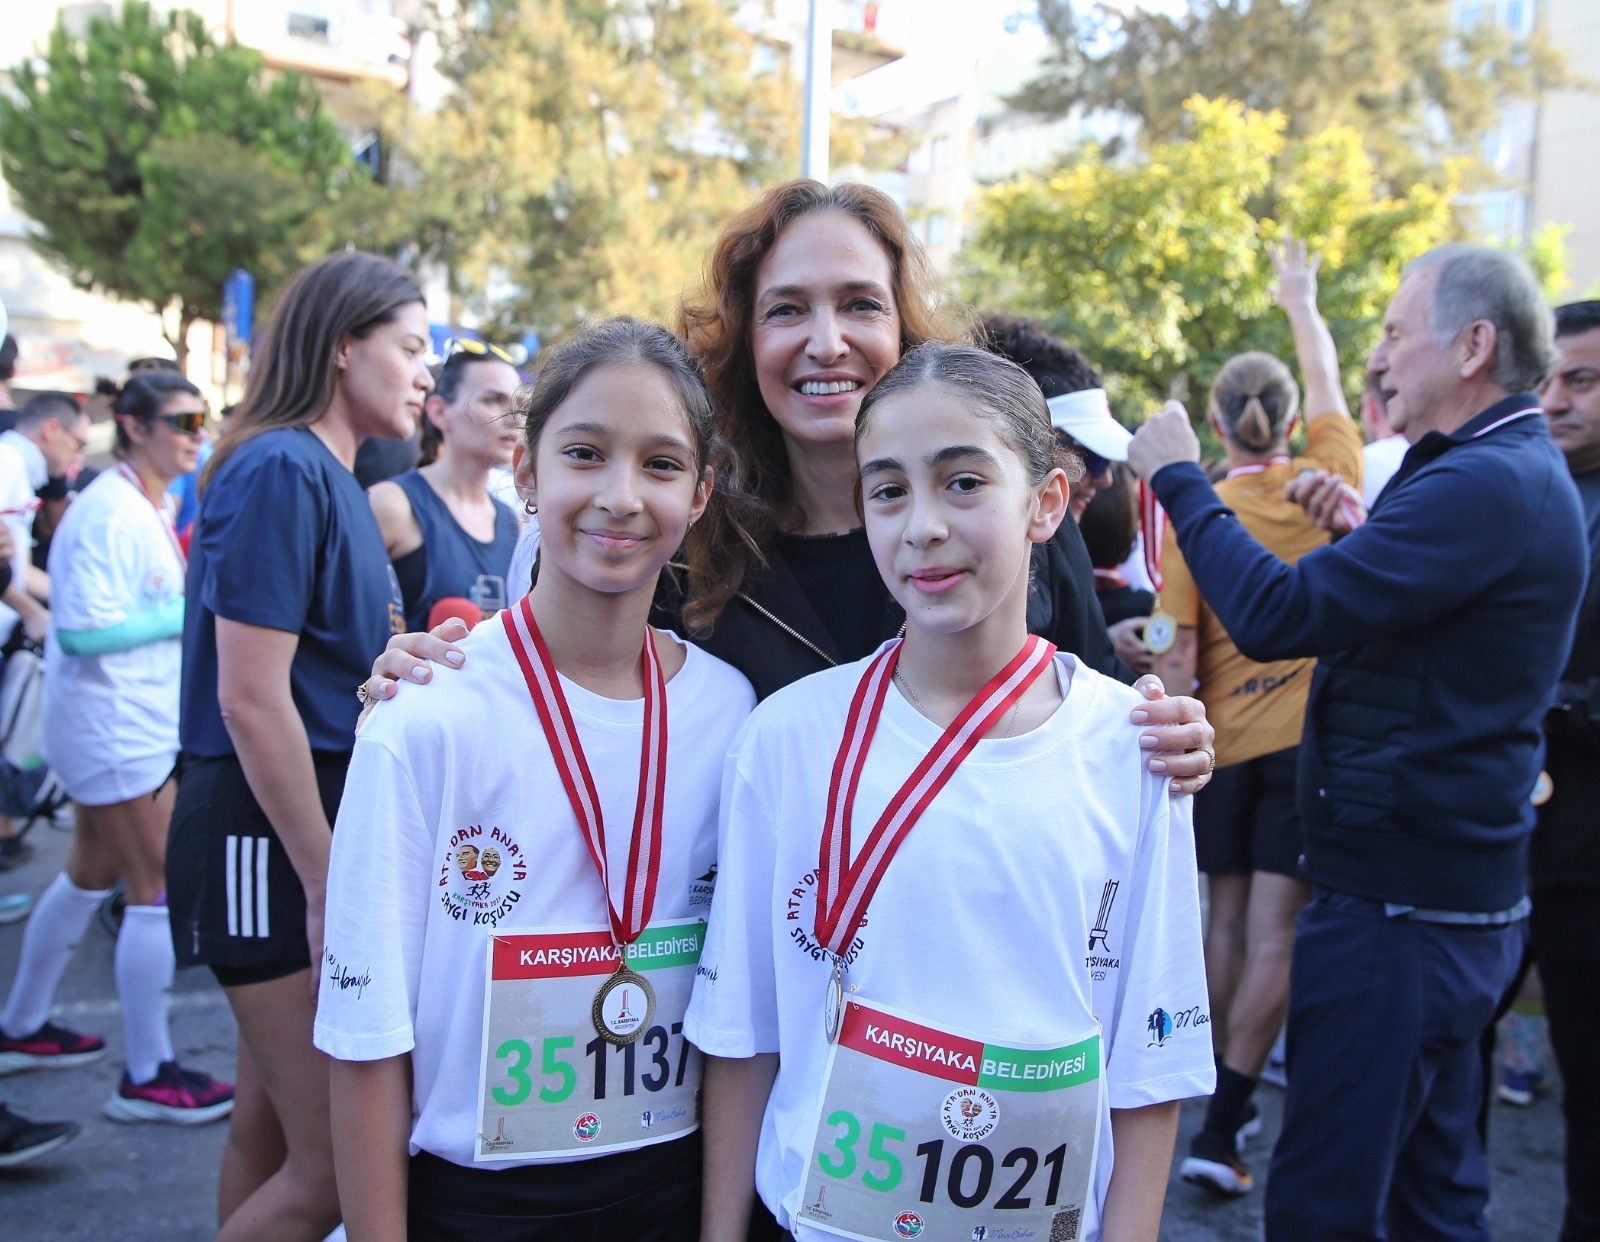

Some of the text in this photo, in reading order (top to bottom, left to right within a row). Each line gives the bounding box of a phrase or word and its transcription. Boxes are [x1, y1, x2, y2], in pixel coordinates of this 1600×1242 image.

[439, 824, 527, 887] ATA'DAN ANA'YA
[441, 890, 522, 929] SAYGI KOŞUSU
[520, 934, 698, 968] KARŞIYAKA BELEDİYESİ
[491, 1021, 691, 1107] 35 1137
[865, 1024, 1086, 1080] KARŞIYAKA BELEDİYESİ
[943, 1089, 976, 1112] ATA'DAN
[943, 1114, 961, 1136] SAYGI
[962, 1123, 994, 1141] KOŞUSU
[817, 1109, 1067, 1210] 35 1021
